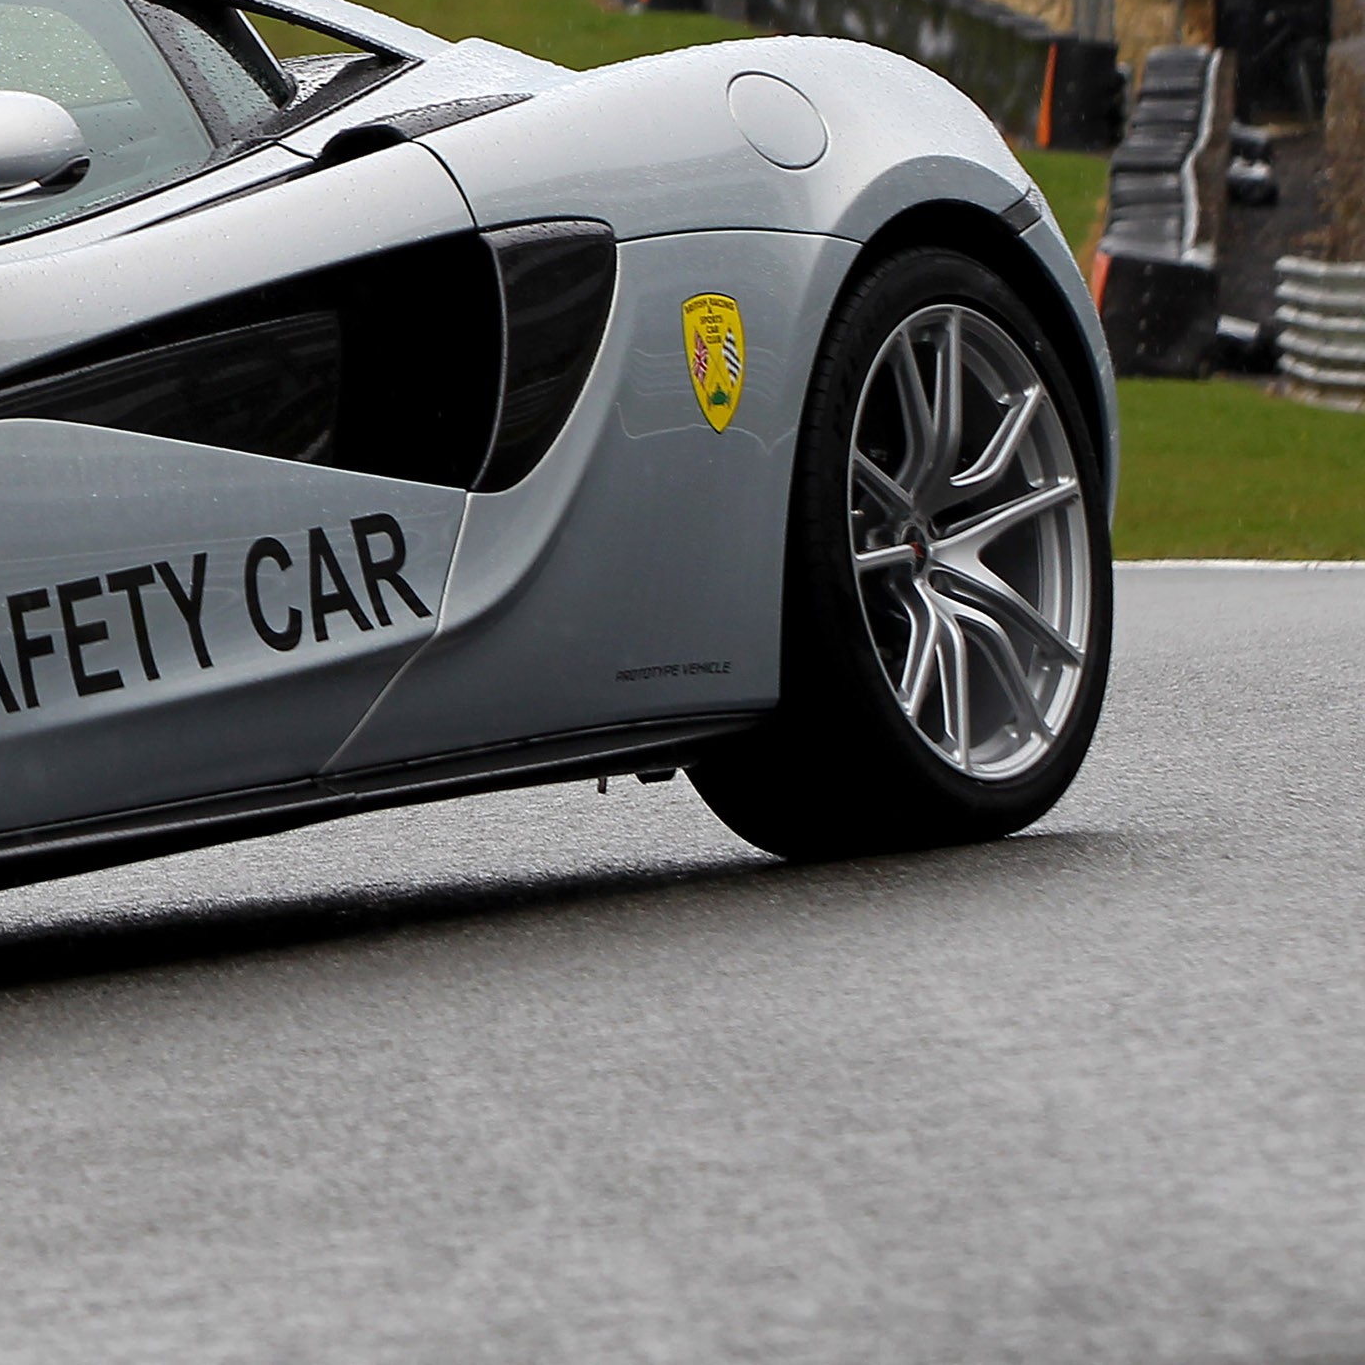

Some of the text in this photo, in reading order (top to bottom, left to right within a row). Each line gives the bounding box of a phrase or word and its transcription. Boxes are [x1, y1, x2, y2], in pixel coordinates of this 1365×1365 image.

[699, 315, 723, 324] SPORTS
[706, 325, 719, 334] CAR
[706, 335, 722, 344] CLUB
[244, 512, 434, 652] CAR
[682, 661, 732, 675] VEHICLE
